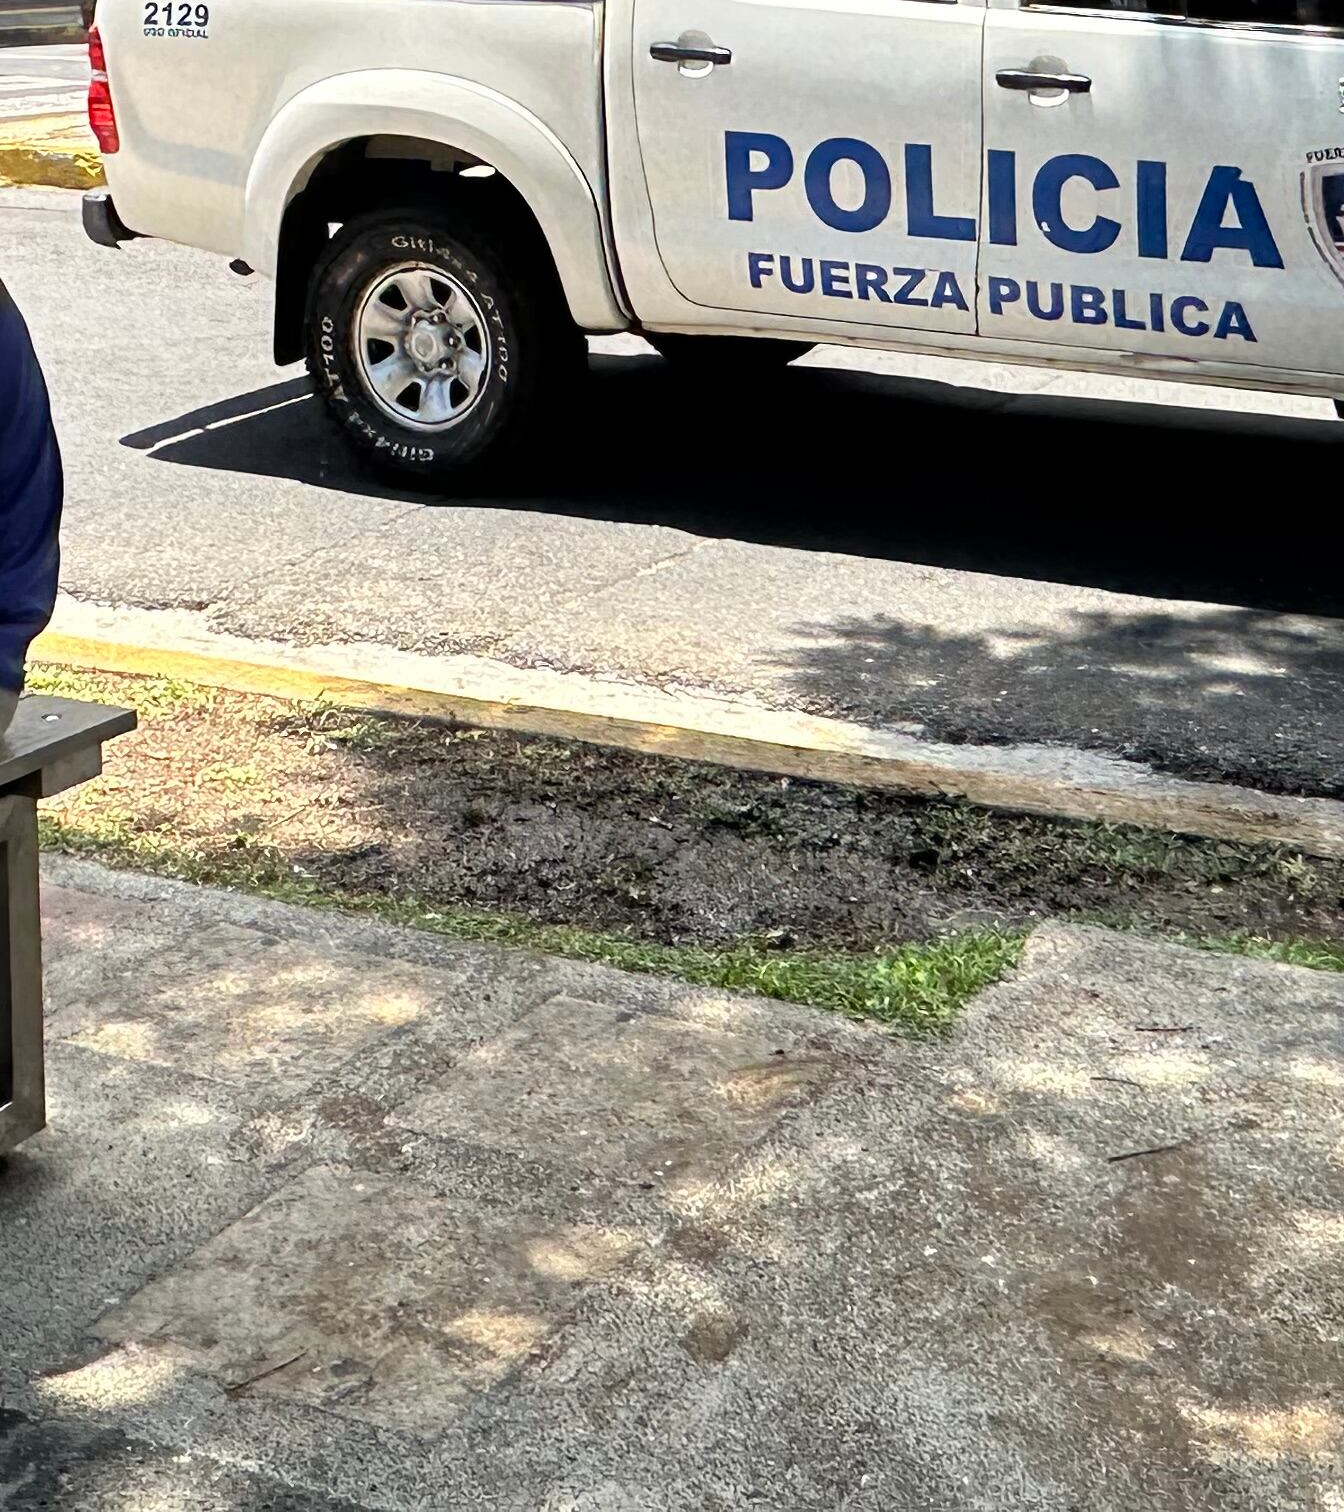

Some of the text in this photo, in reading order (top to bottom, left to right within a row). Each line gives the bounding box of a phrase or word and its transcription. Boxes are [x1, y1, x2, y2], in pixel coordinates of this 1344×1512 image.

[144, 1, 209, 28] 2129
[724, 130, 1286, 270] POLICIA
[748, 253, 1259, 343] FUERZA PUBLICA
